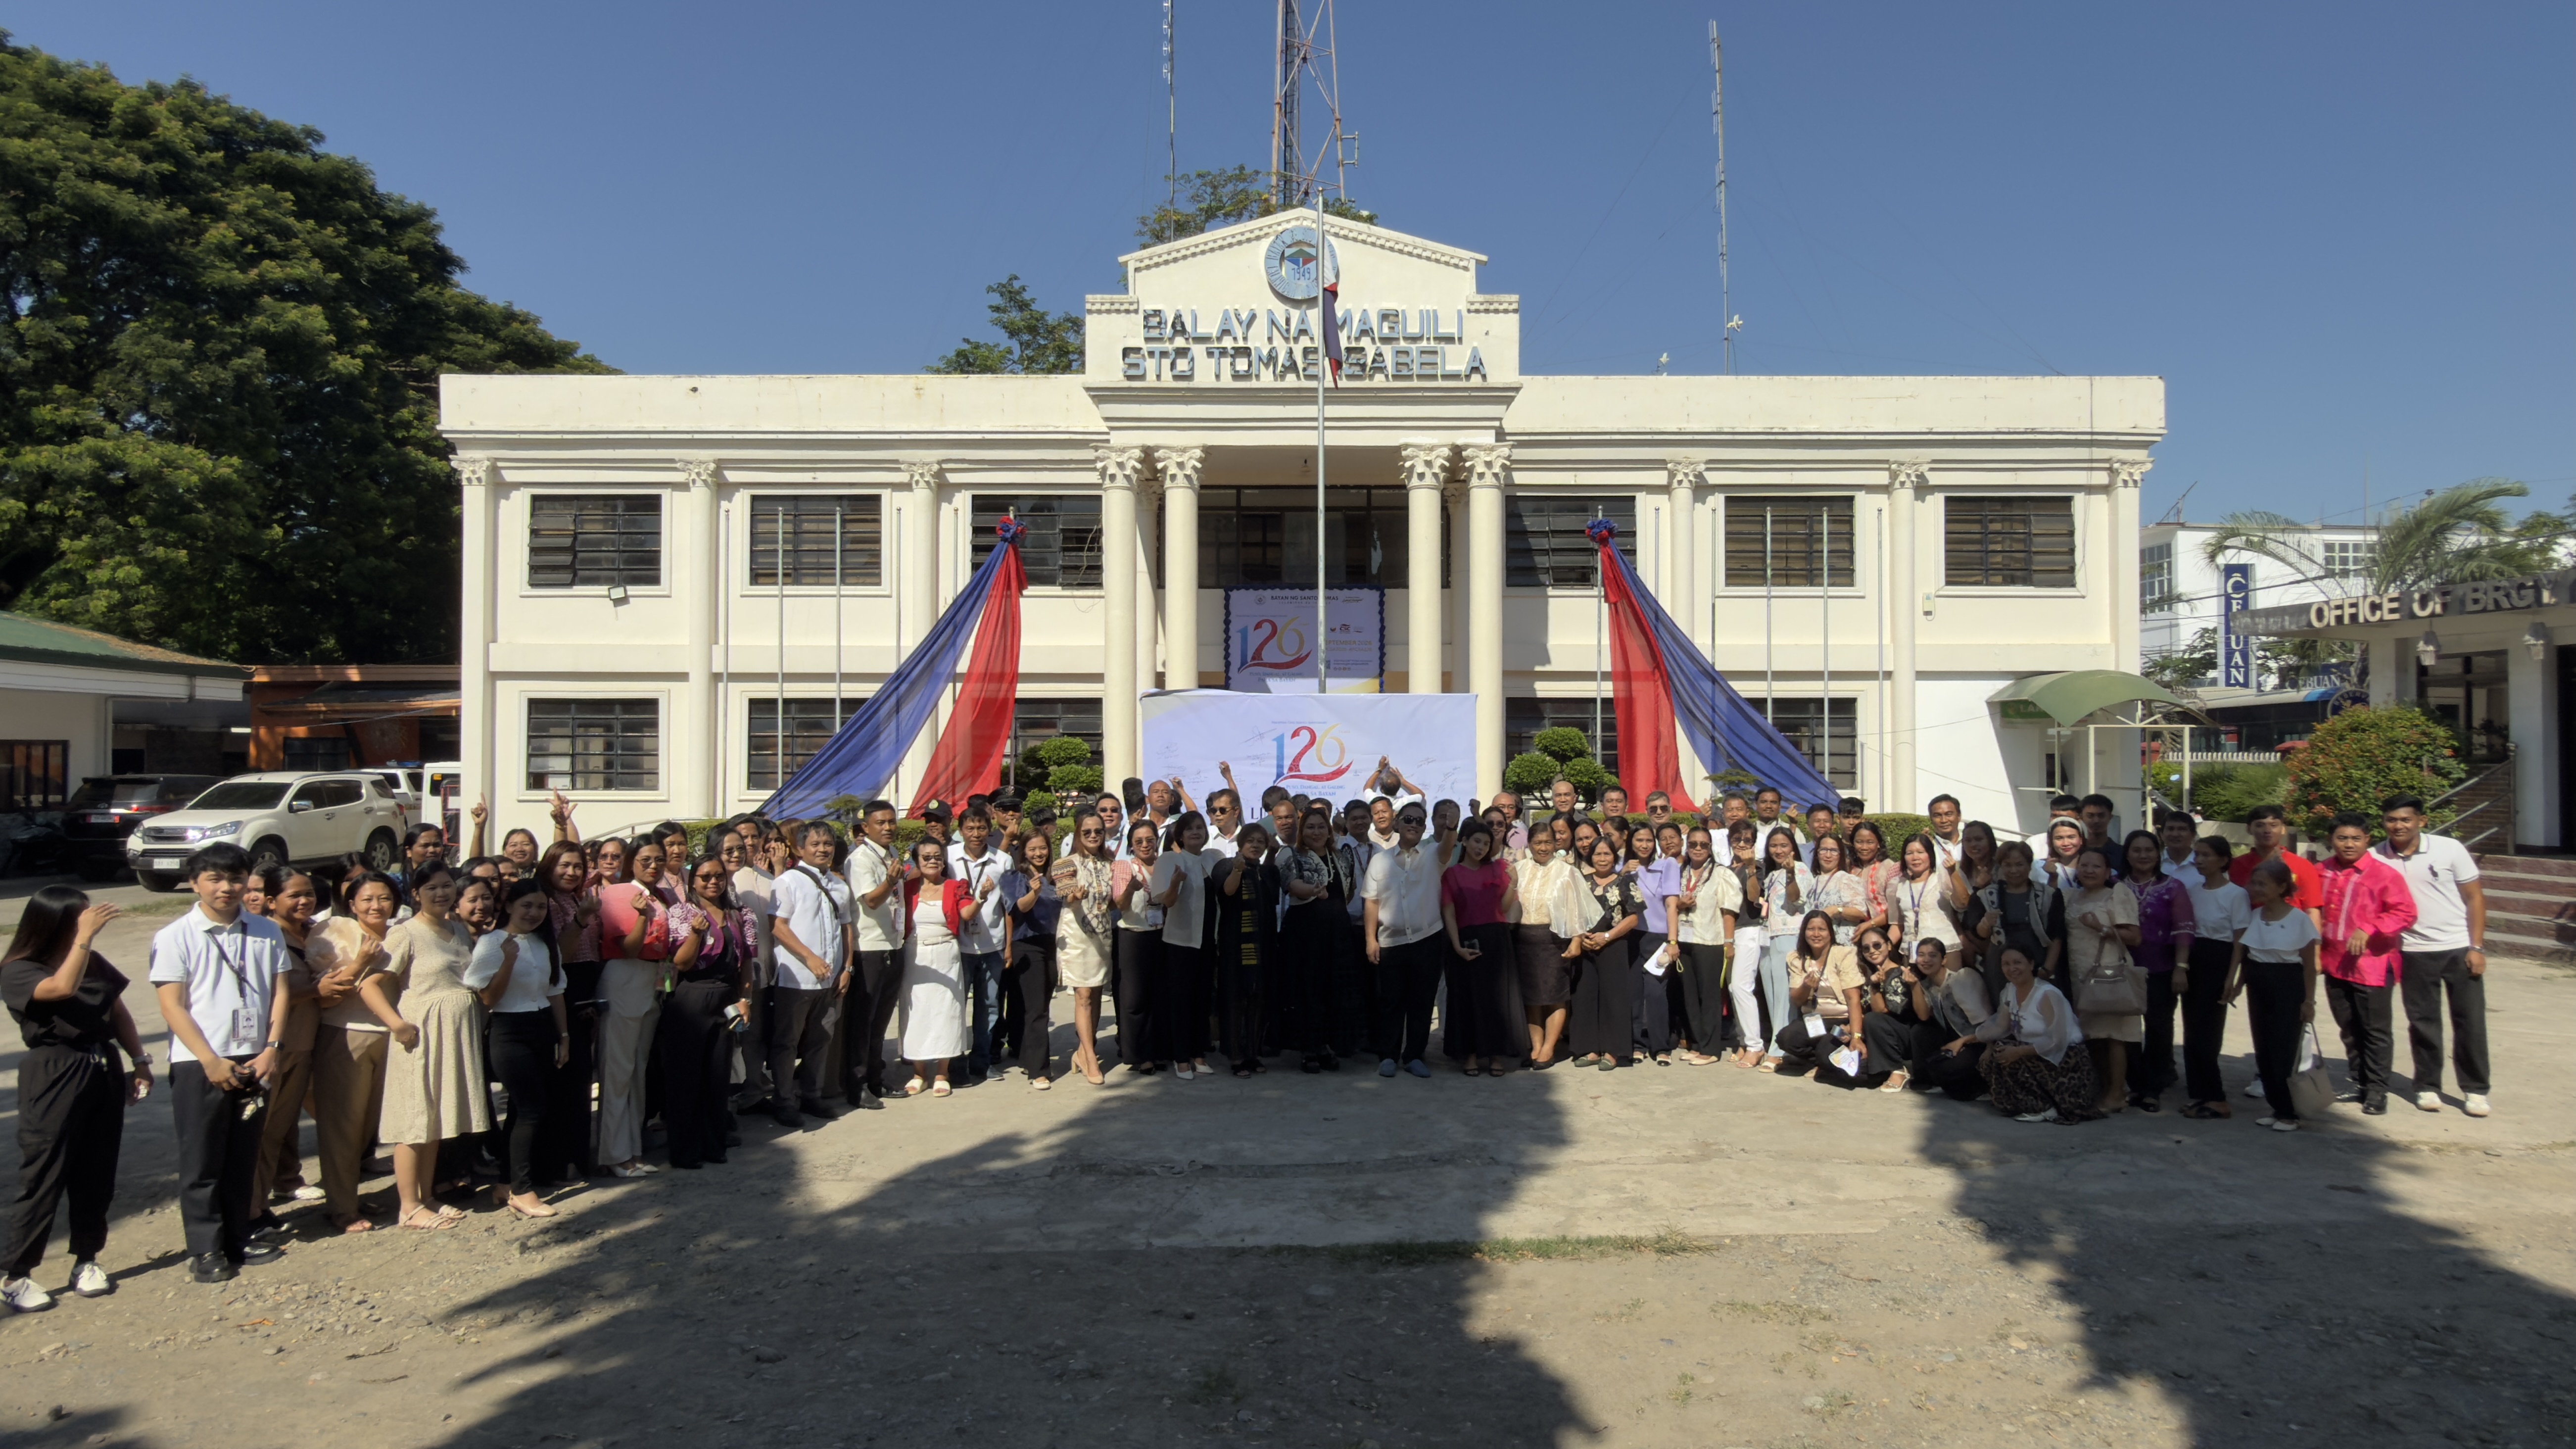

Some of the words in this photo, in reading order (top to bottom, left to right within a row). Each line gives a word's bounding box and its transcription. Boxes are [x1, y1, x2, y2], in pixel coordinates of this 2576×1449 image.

[1291, 267, 1311, 281] 1949
[1143, 309, 1256, 342] BALAY
[1267, 309, 1315, 342] NA
[1122, 347, 1194, 380] STO
[1206, 347, 1325, 381] TOMAS
[1338, 347, 1486, 381] SABELA
[2310, 593, 2401, 628] OFFICE
[2412, 588, 2451, 617] OF
[1236, 616, 1309, 674] 126
[2227, 576, 2246, 687] CEUAN
[2286, 675, 2342, 689] CEBUAN
[1271, 723, 1350, 785] 126
